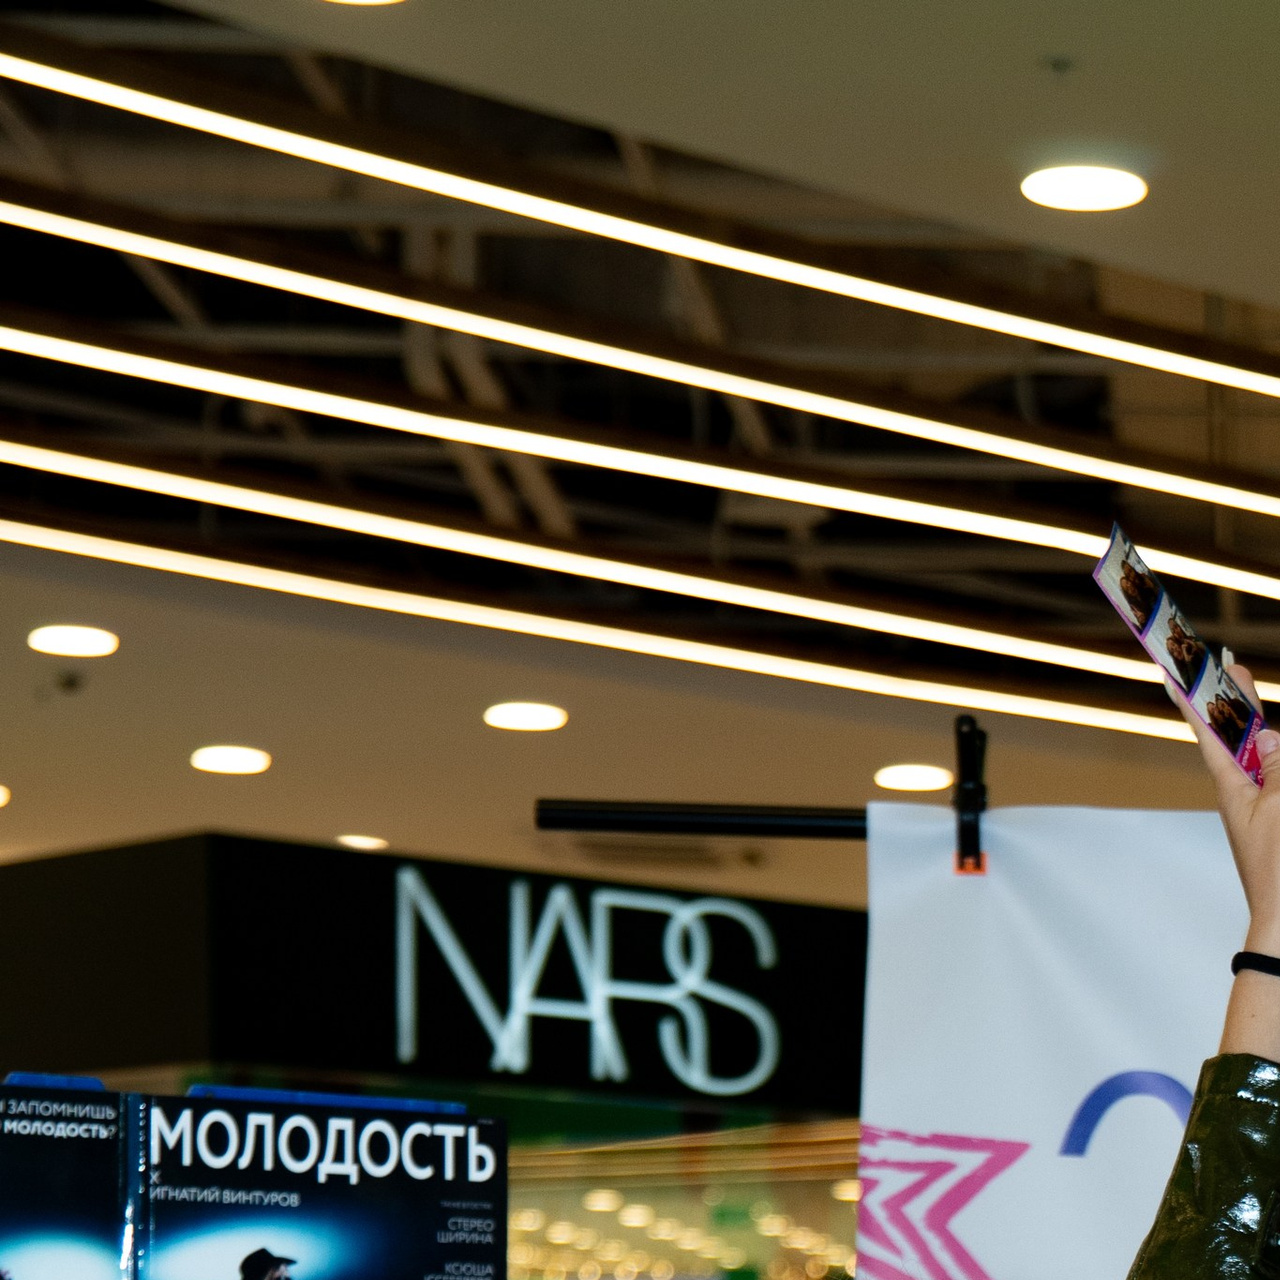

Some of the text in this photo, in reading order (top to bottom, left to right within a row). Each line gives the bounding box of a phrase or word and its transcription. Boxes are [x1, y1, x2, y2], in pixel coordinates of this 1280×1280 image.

[396, 865, 780, 1097] NARS
[7, 1100, 117, 1120] ЗАПОМНИШЬ
[4, 1120, 118, 1139] МОЛОДОСТЬ?
[150, 1107, 496, 1185] МОЛОДОСТЬ
[149, 1186, 299, 1207] ИГНАТИЙ ВИНТУРОВ
[447, 1217, 495, 1232] СТЕРЕО
[437, 1231, 493, 1244] ШИРИНА
[444, 1262, 494, 1276] КСЮША
